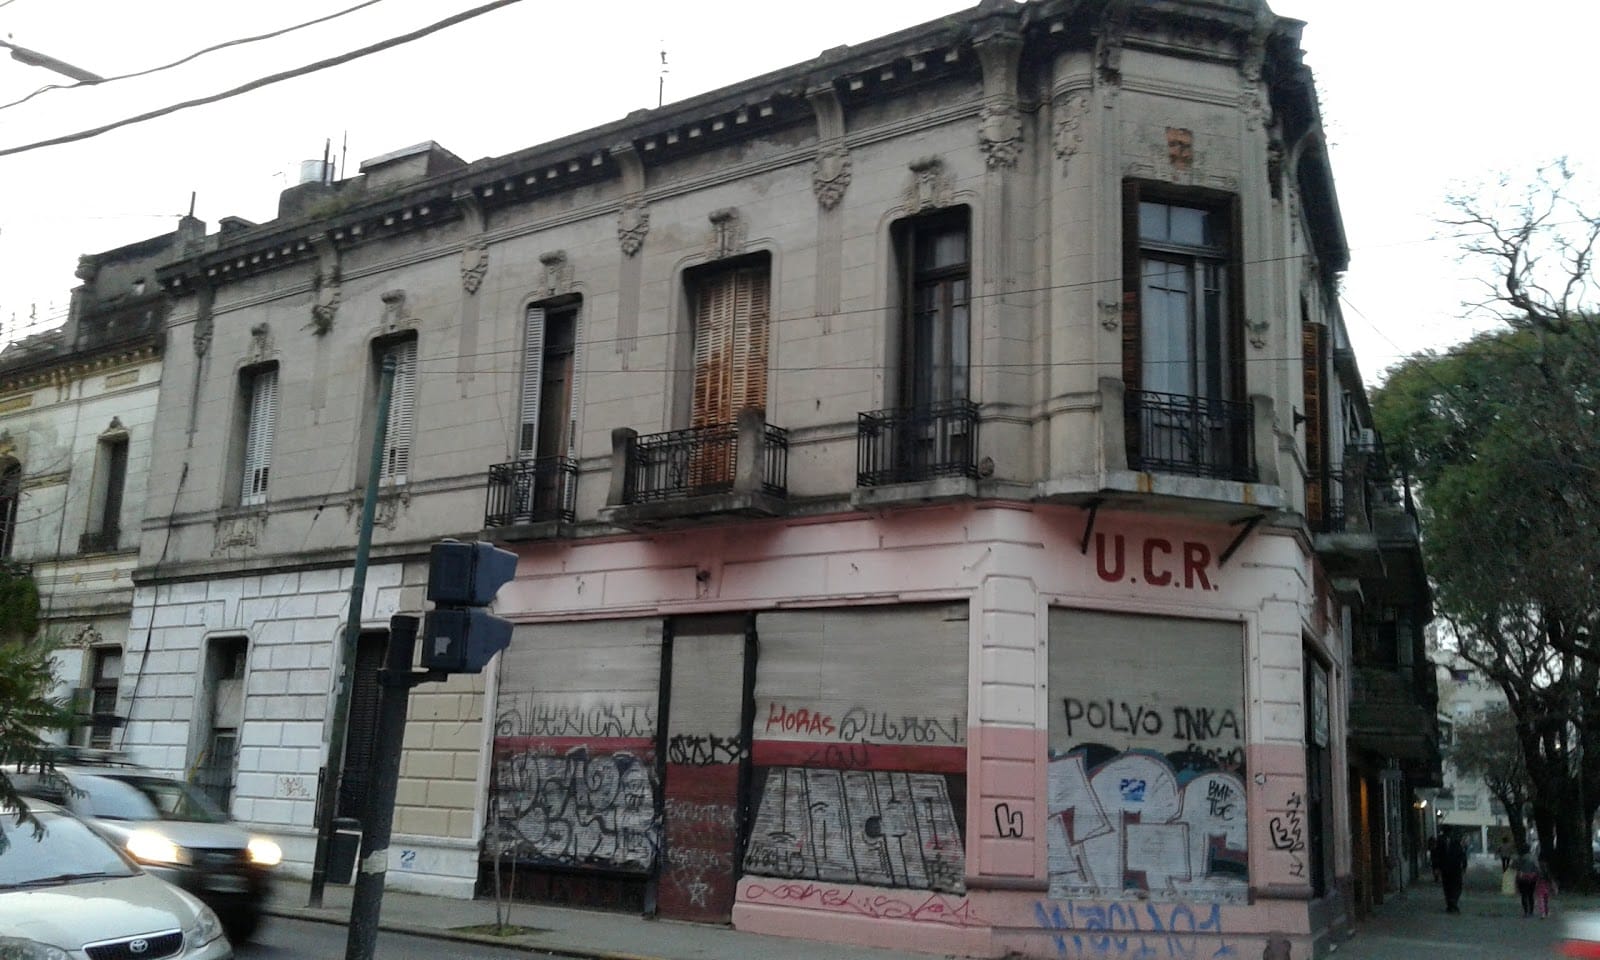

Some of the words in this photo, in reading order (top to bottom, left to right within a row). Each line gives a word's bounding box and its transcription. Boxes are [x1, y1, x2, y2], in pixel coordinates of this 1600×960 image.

[1095, 532, 1219, 591] U.C.R.
[1063, 697, 1163, 737] POLVO
[1173, 705, 1241, 741] INKA
